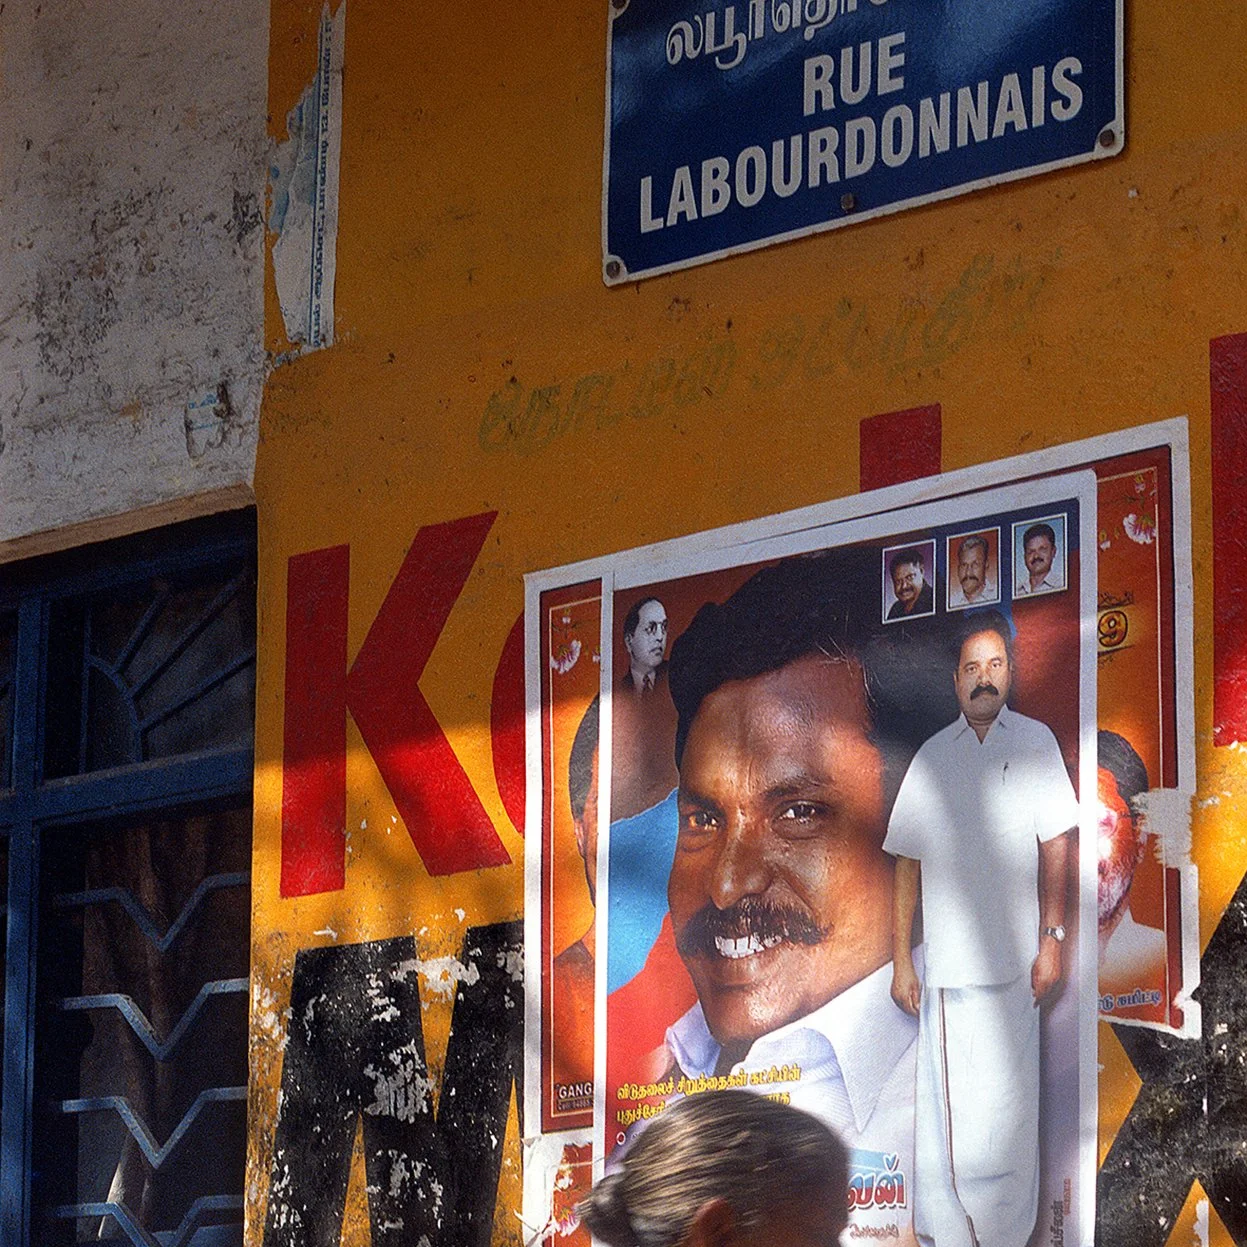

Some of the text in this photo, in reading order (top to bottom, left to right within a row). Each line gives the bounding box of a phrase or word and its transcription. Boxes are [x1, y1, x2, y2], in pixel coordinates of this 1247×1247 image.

[802, 31, 907, 116] RUE
[639, 56, 1084, 235] LABOURDONNAIS
[557, 1081, 594, 1100] GANG
[616, 1077, 675, 1101] விடுதலைச்
